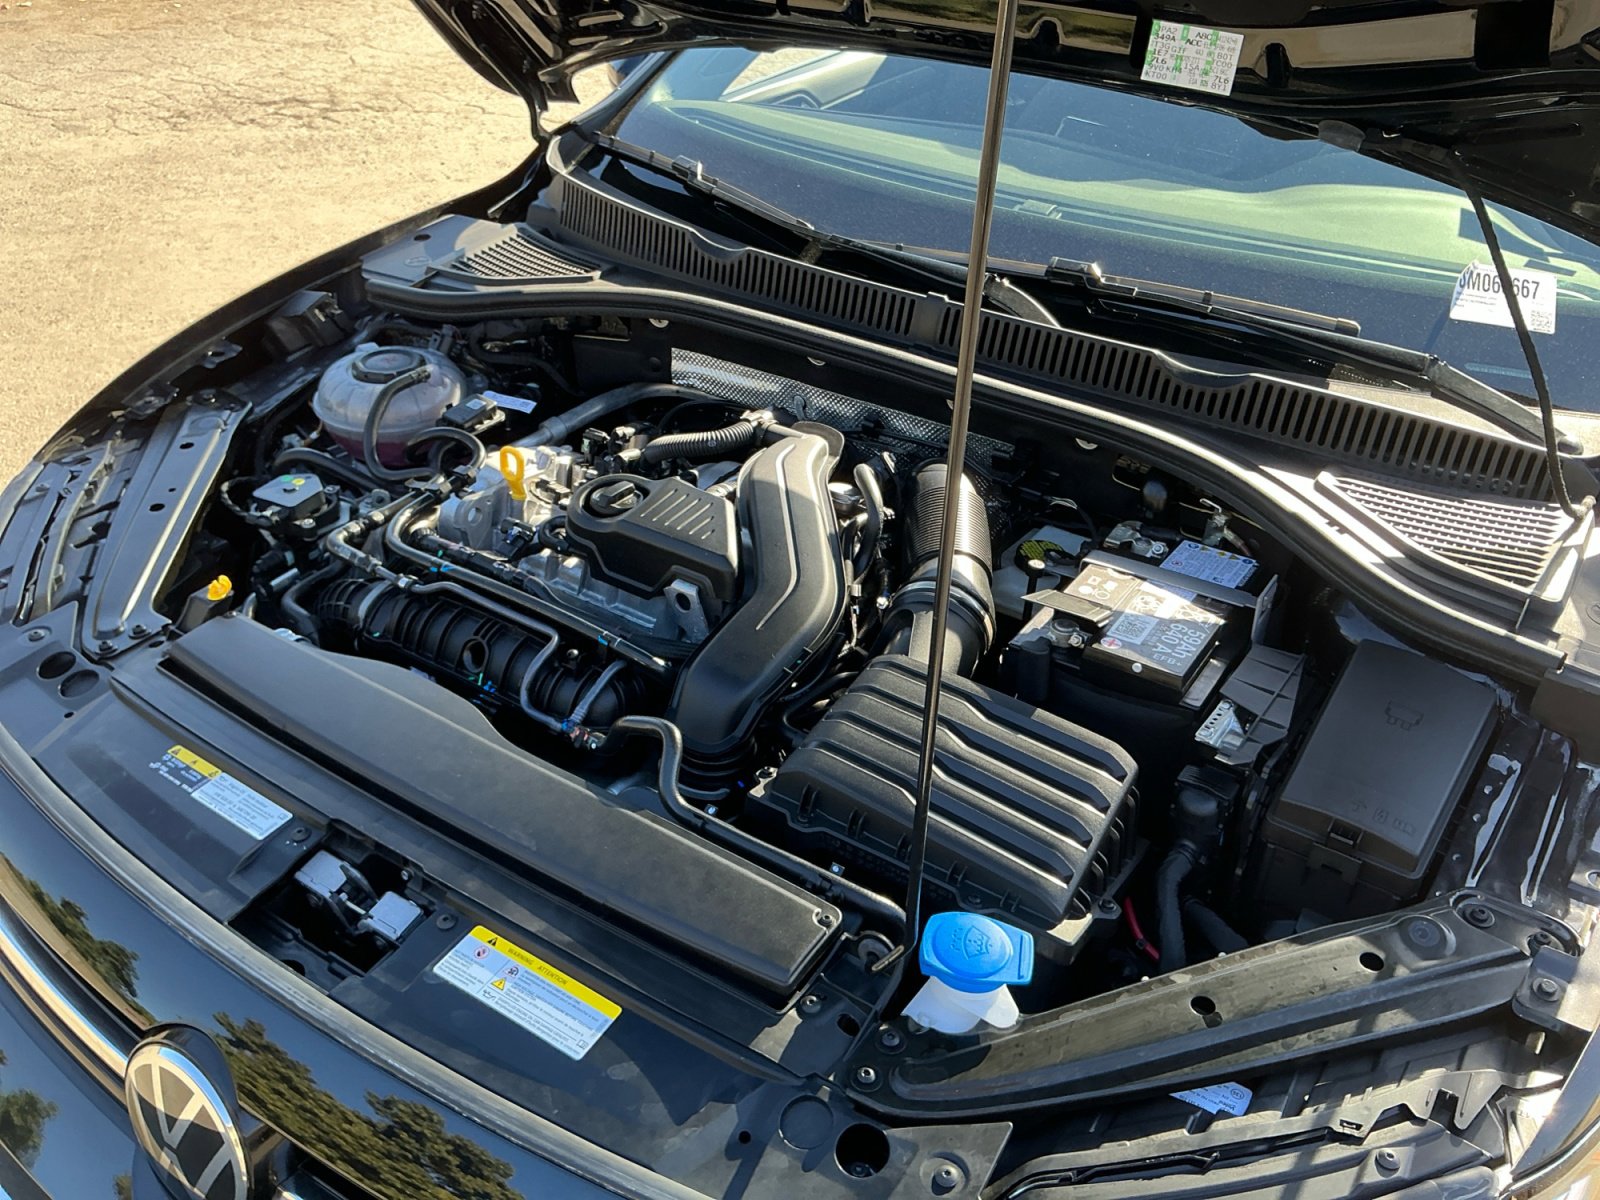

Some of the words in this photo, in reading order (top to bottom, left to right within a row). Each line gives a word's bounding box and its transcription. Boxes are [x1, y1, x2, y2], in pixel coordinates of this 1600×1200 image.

[1459, 267, 1540, 299] SM06667
[1161, 623, 1188, 645] 640
[1171, 629, 1207, 659] 59Ah
[1152, 643, 1172, 654] A
[537, 965, 569, 984] ATTENTION
